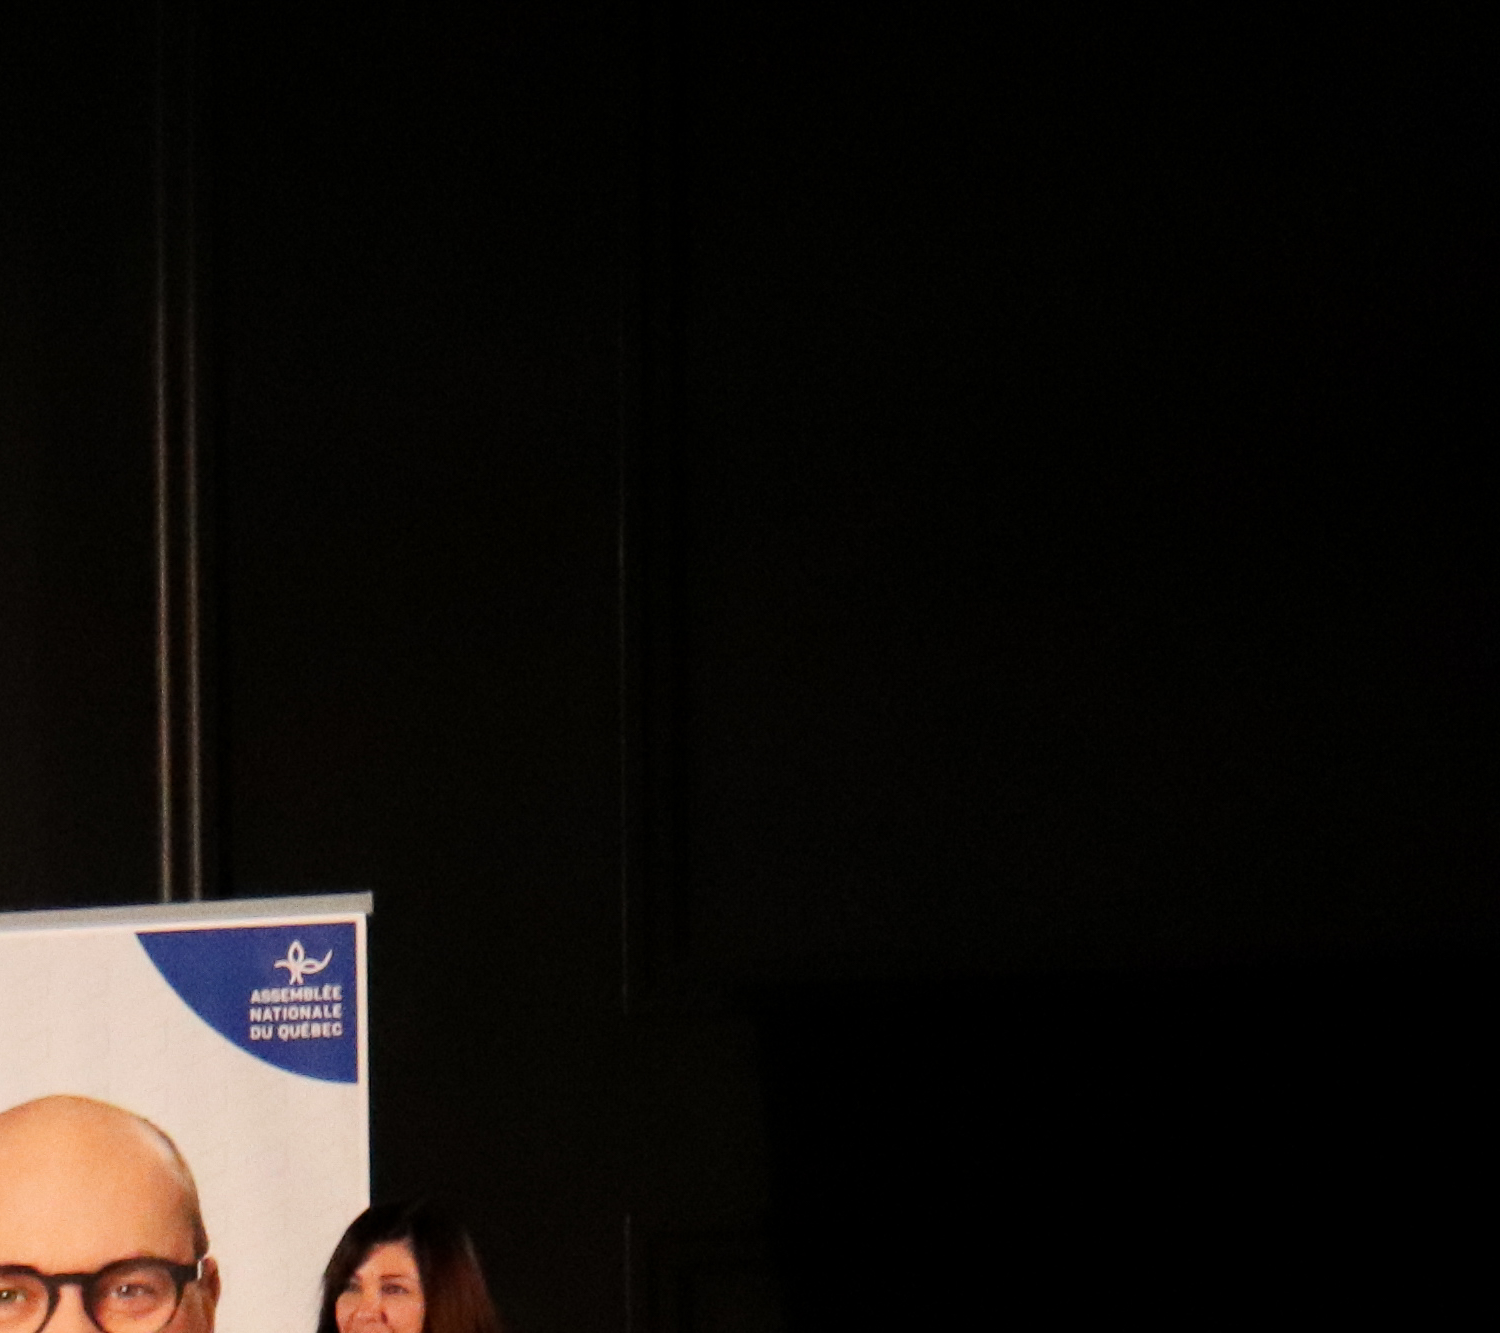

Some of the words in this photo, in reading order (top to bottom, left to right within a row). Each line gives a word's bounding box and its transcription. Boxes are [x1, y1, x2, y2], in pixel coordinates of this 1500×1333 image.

[251, 984, 342, 1003] ASSEMBLÉE
[250, 1004, 342, 1022] NATIONALE
[250, 1024, 273, 1040] DU
[278, 1022, 342, 1041] QUÉBEC
